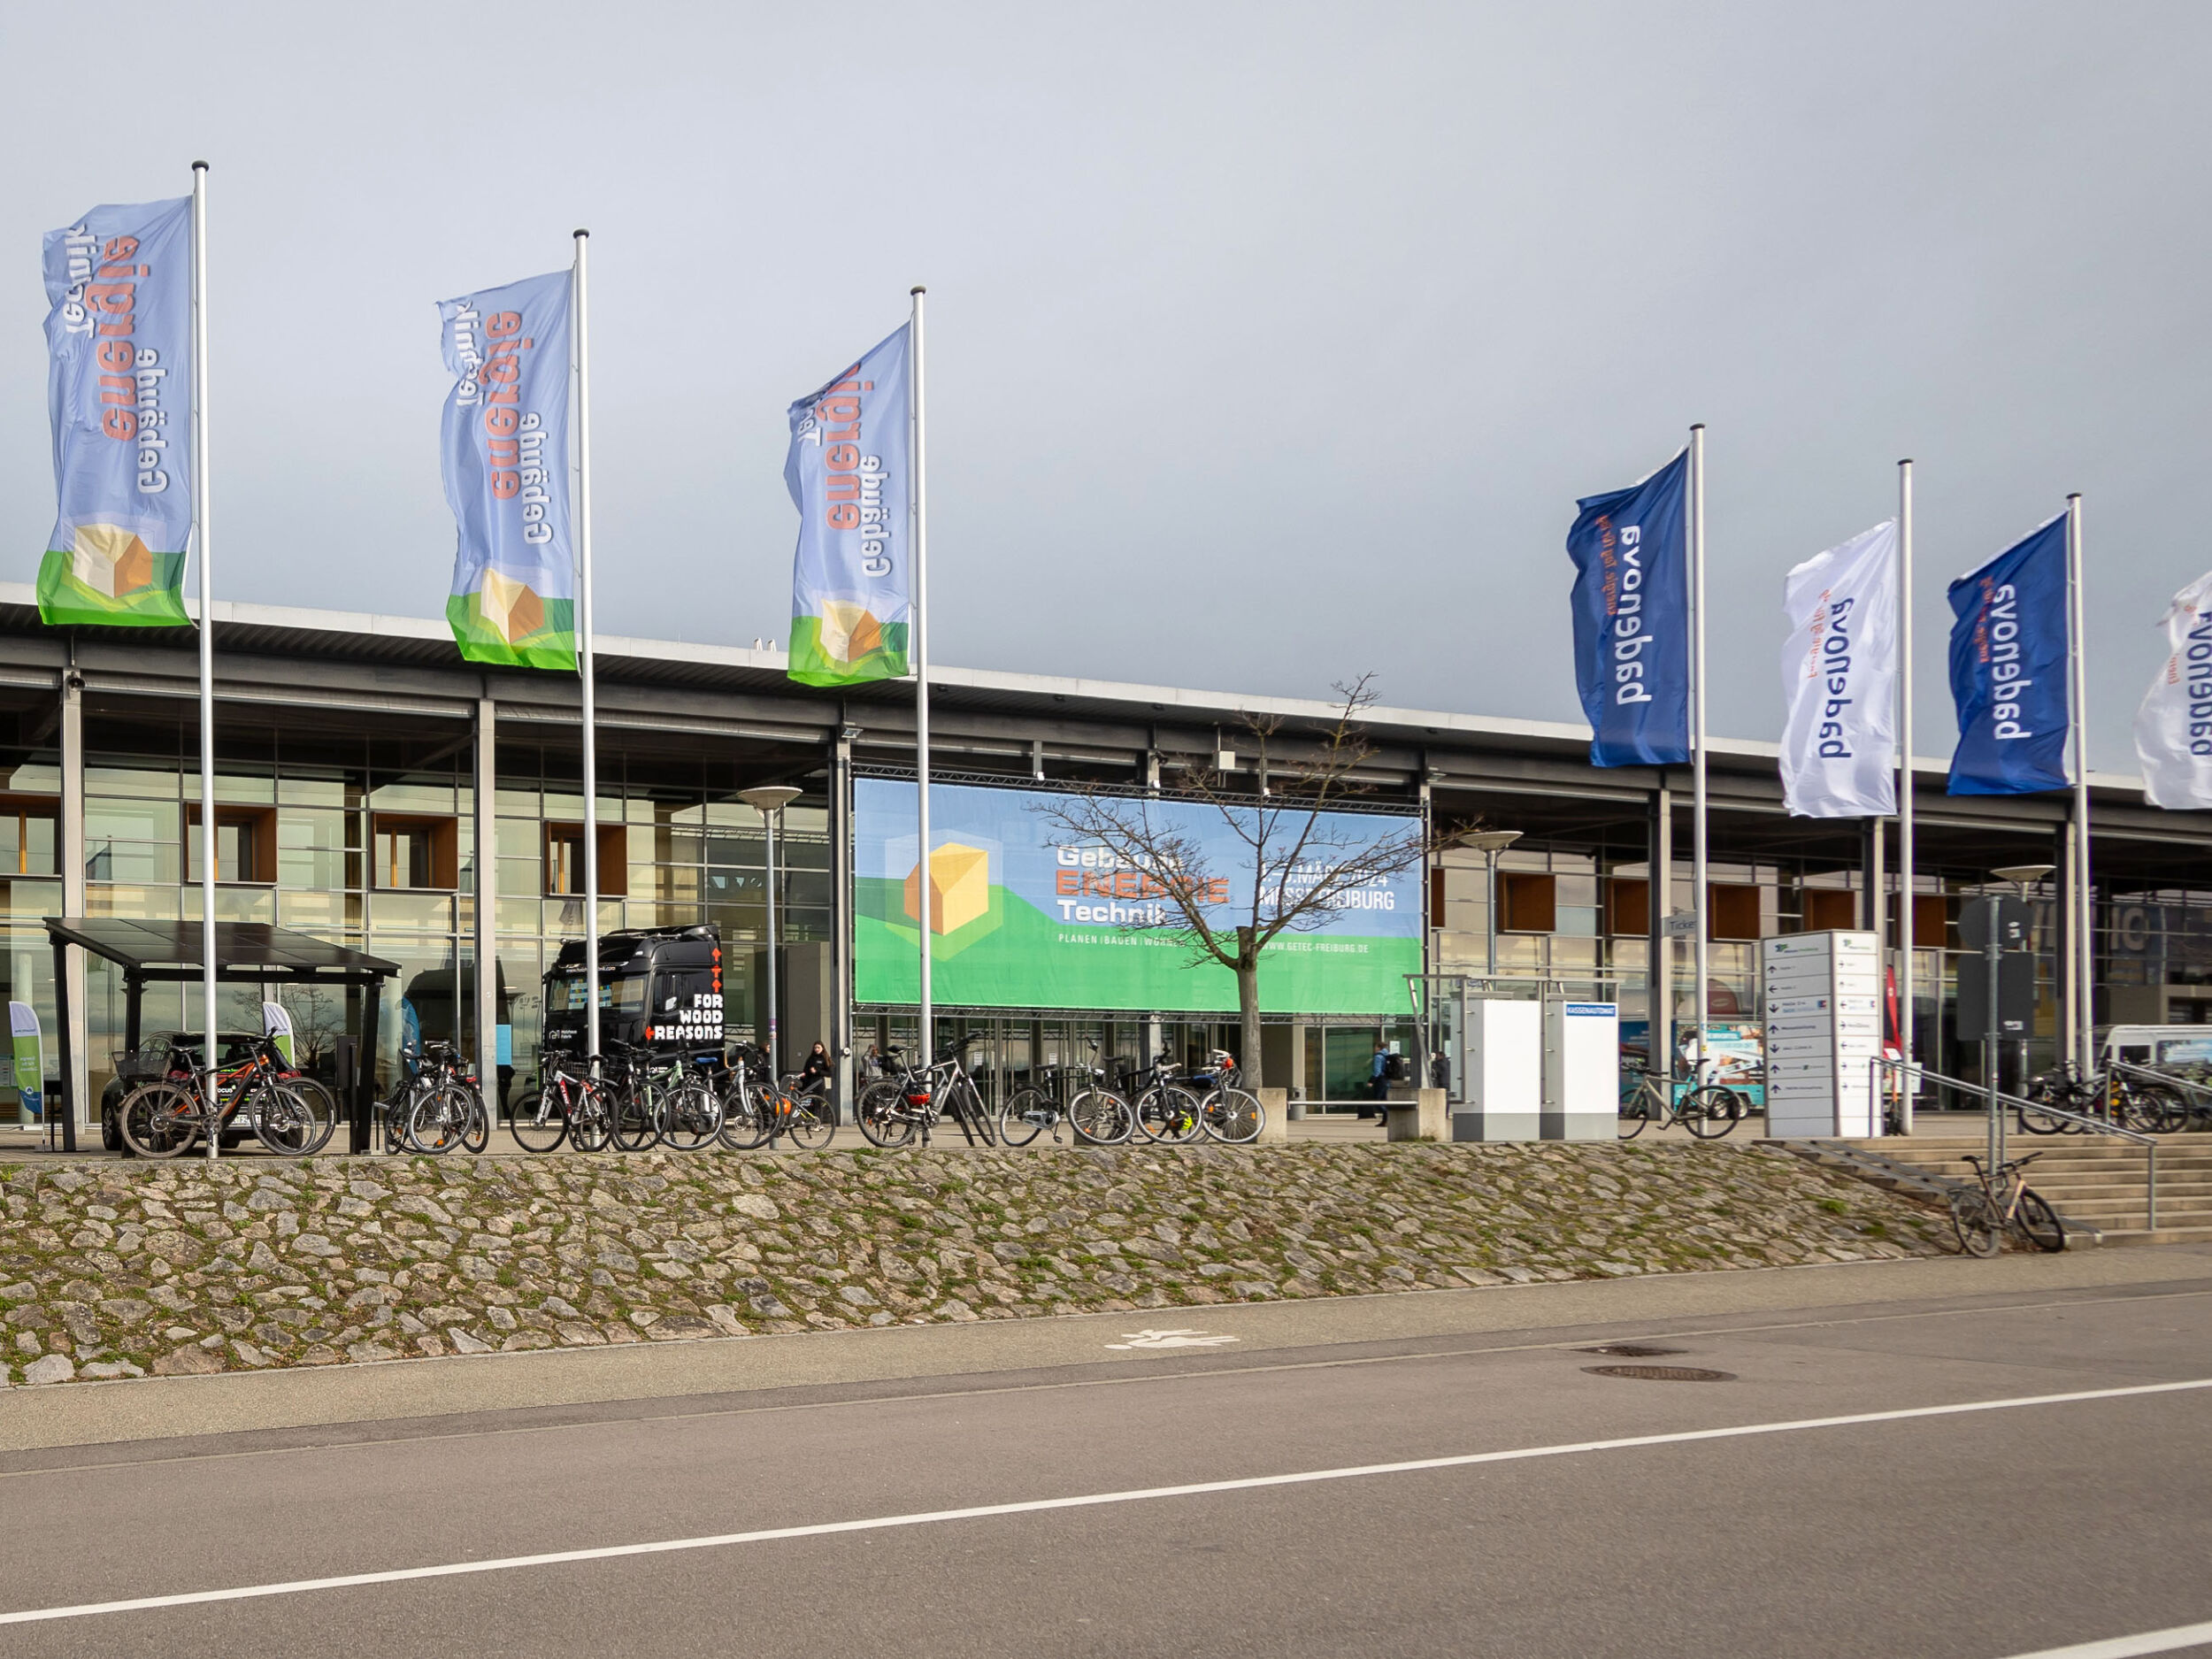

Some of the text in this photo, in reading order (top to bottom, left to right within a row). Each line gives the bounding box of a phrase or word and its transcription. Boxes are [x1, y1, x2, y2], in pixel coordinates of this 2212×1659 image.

[1056, 899, 1167, 925] Technik
[1058, 933, 1097, 944] PLANEN
[694, 994, 724, 1009] FOR
[679, 1010, 724, 1024] WOOD
[654, 1025, 724, 1040] REASONS
